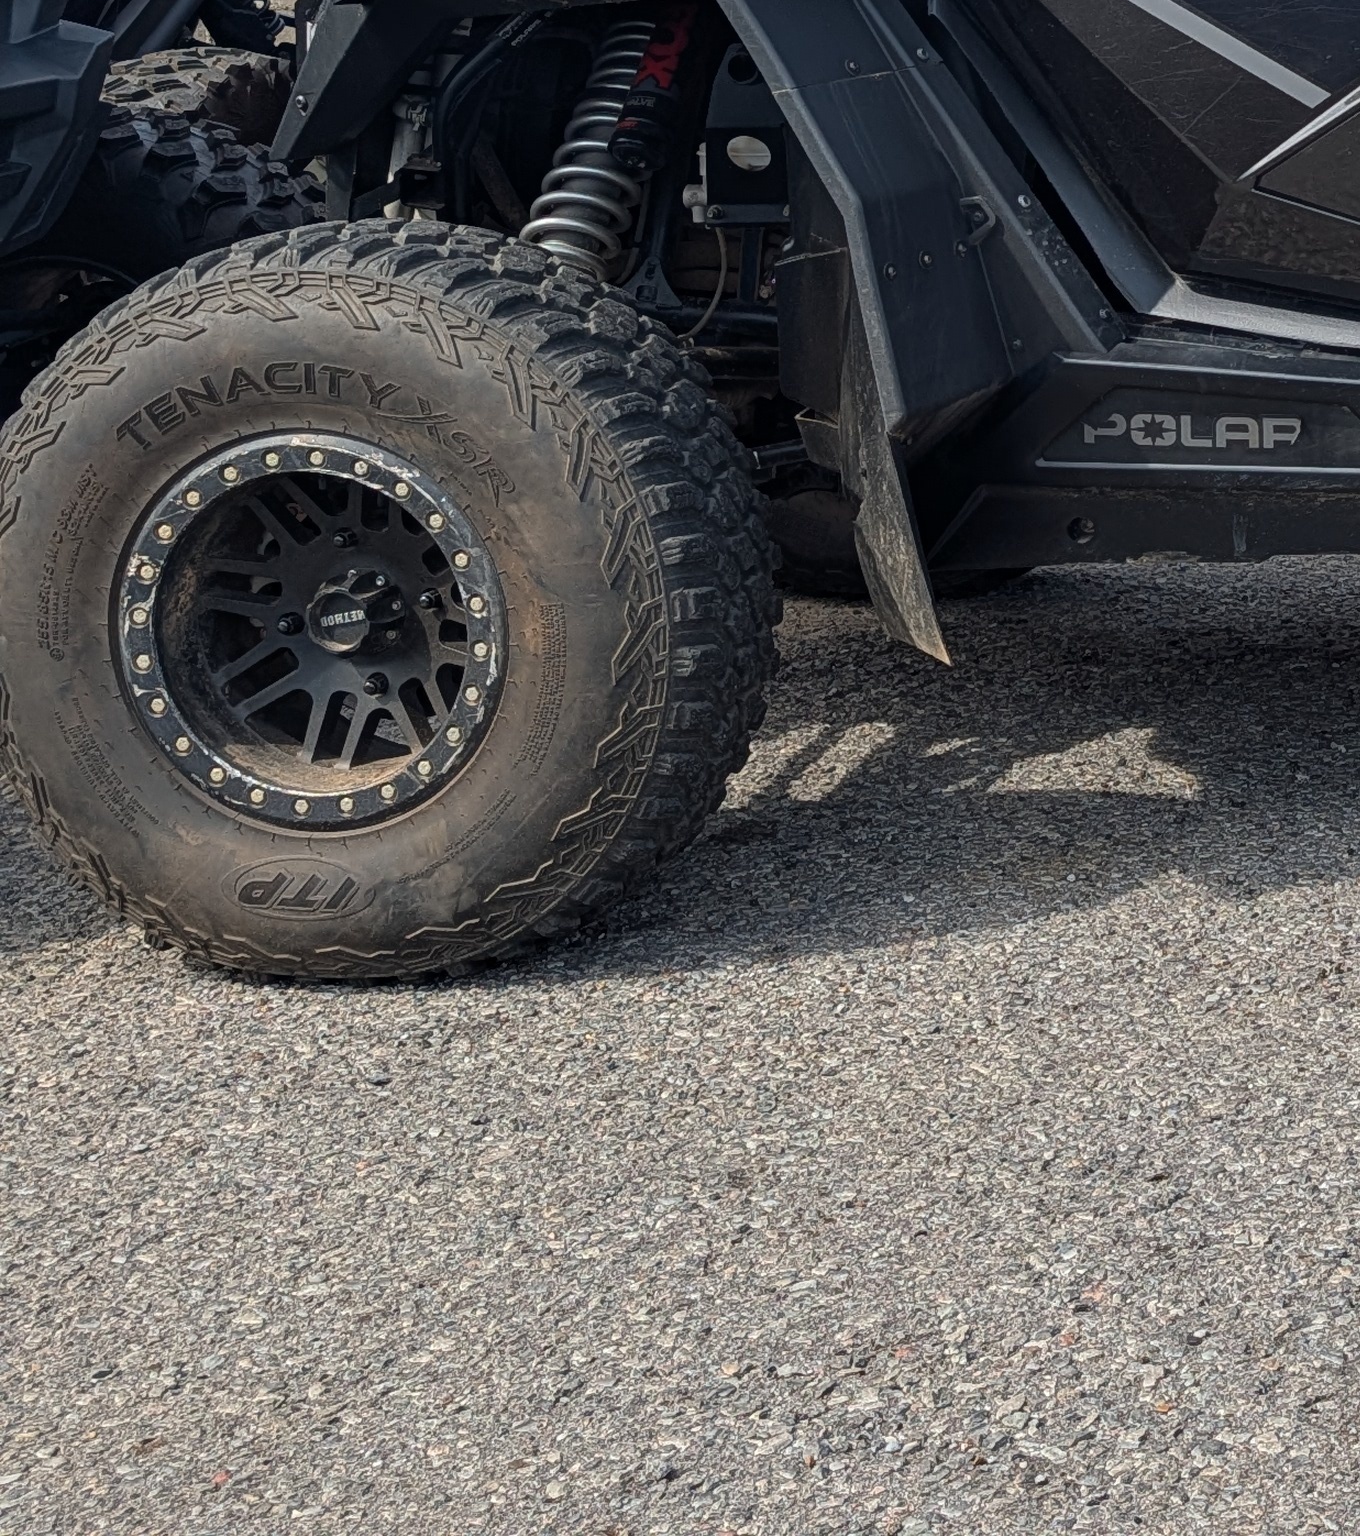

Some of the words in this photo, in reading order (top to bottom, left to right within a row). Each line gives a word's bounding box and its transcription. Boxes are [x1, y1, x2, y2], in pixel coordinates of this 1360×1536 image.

[116, 362, 401, 451] TENACITY
[376, 394, 517, 508] XSR
[320, 609, 366, 627] METHOD
[237, 867, 361, 914] ITP
